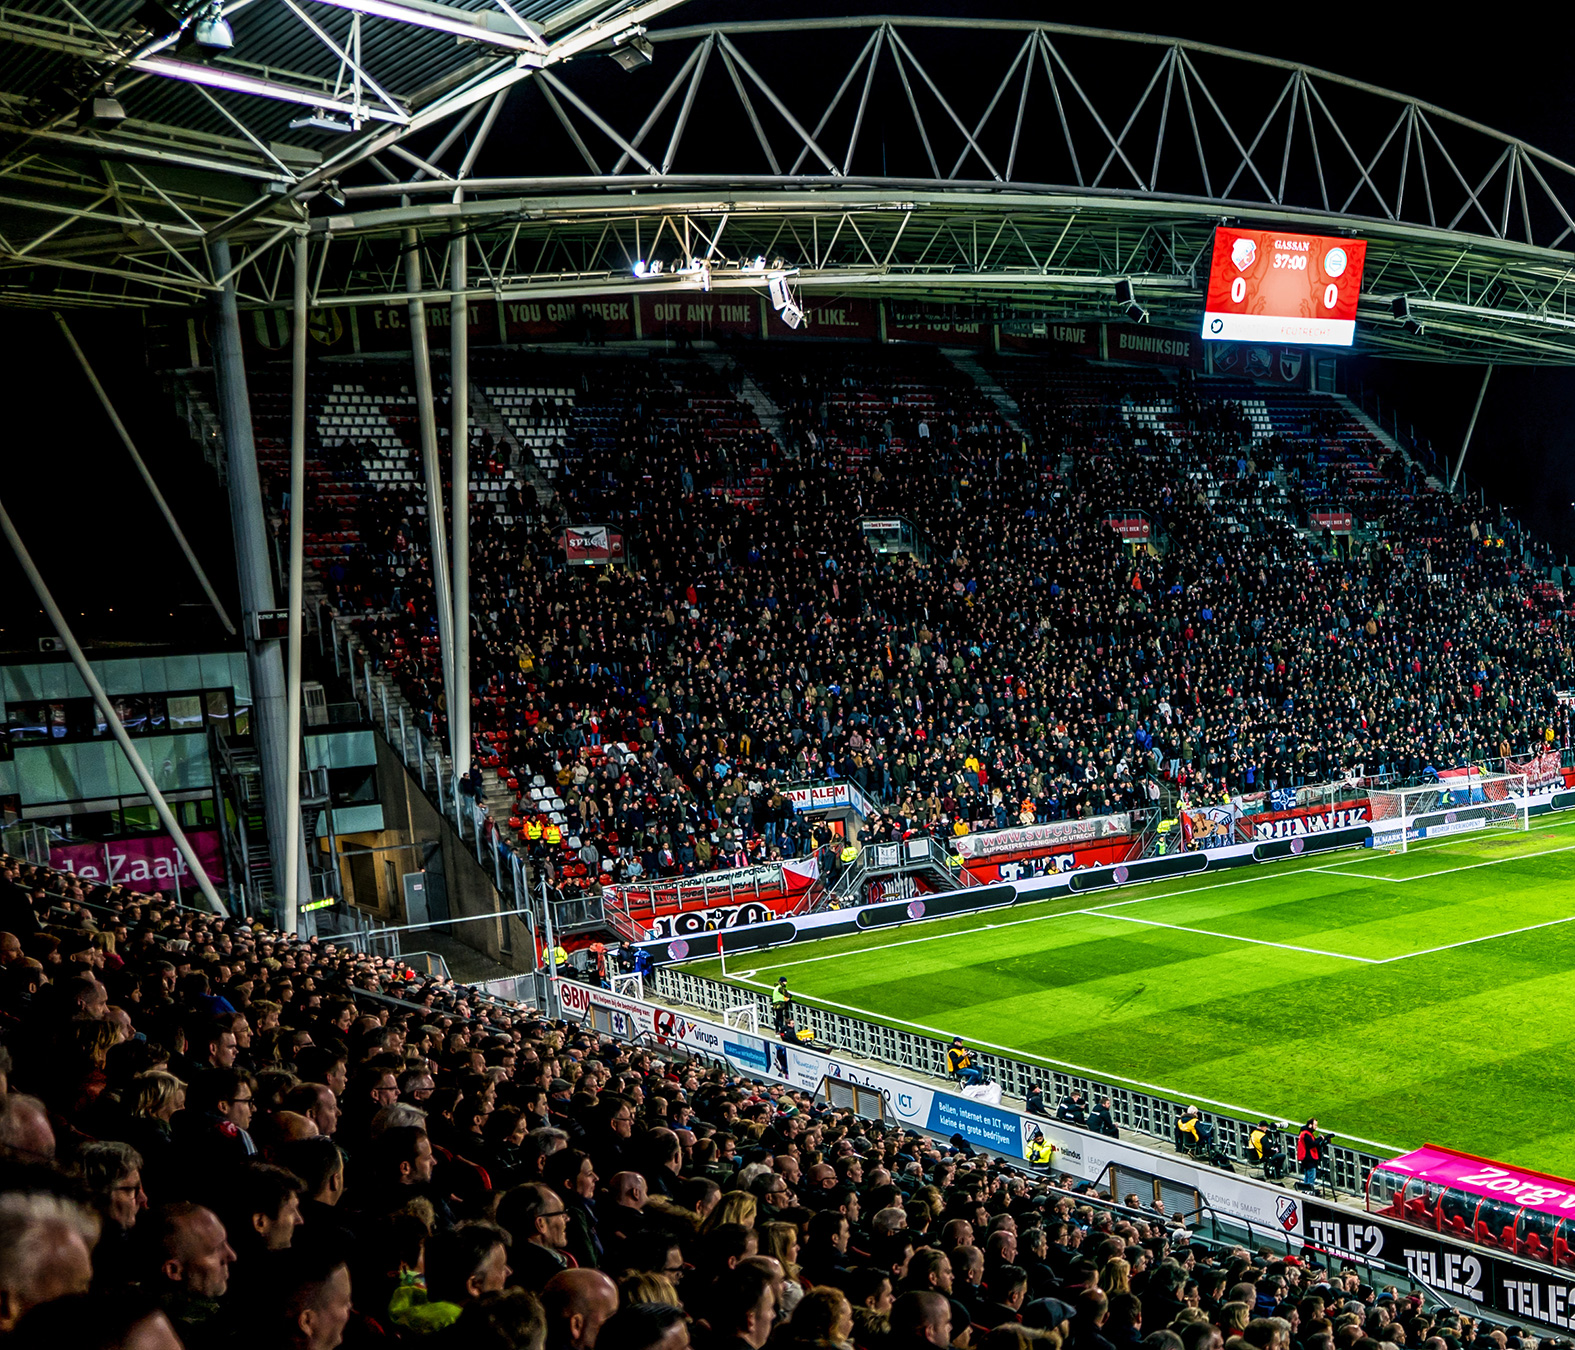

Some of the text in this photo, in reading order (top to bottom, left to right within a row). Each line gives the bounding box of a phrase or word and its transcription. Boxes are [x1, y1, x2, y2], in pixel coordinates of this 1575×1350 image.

[1274, 240, 1310, 251] GASSAN
[1273, 254, 1307, 270] 37:00
[1231, 277, 1246, 303] 0
[1324, 283, 1338, 309] 0
[374, 309, 406, 329] F.C.
[509, 304, 541, 322] YOU
[546, 303, 576, 321] CAN
[654, 303, 682, 322] OUT
[687, 303, 714, 322] ANY
[720, 305, 751, 323] TIME
[954, 316, 980, 334] CAN
[1053, 325, 1087, 345] LEAVE
[1119, 333, 1190, 358] BUNNIKSIDE
[812, 785, 845, 799] ALEM
[982, 823, 1096, 848] WWW.SVFCU.NL
[1059, 836, 1069, 844] FC
[1068, 831, 1096, 842] UTRECHT
[647, 877, 702, 891] TEMPORARY
[743, 862, 783, 877] FOREVER
[560, 983, 591, 1011] OBM
[598, 995, 612, 1006] helpen
[616, 1000, 622, 1008] de
[621, 1002, 642, 1016] bestrijding
[694, 1028, 718, 1047] virupa
[898, 1093, 913, 1109] ICT
[938, 1101, 1016, 1133] Bellen, internet en ICT voor
[939, 1115, 1010, 1145] kleine én grote bedrijven
[1460, 1166, 1556, 1206] Zorg
[1232, 1200, 1239, 1209] IN
[1240, 1202, 1261, 1215] SMART
[1279, 1202, 1296, 1225] UTRECHT
[1280, 1199, 1285, 1209] F
[1310, 1220, 1386, 1270] TELE2
[1403, 1249, 1484, 1303] TELE2
